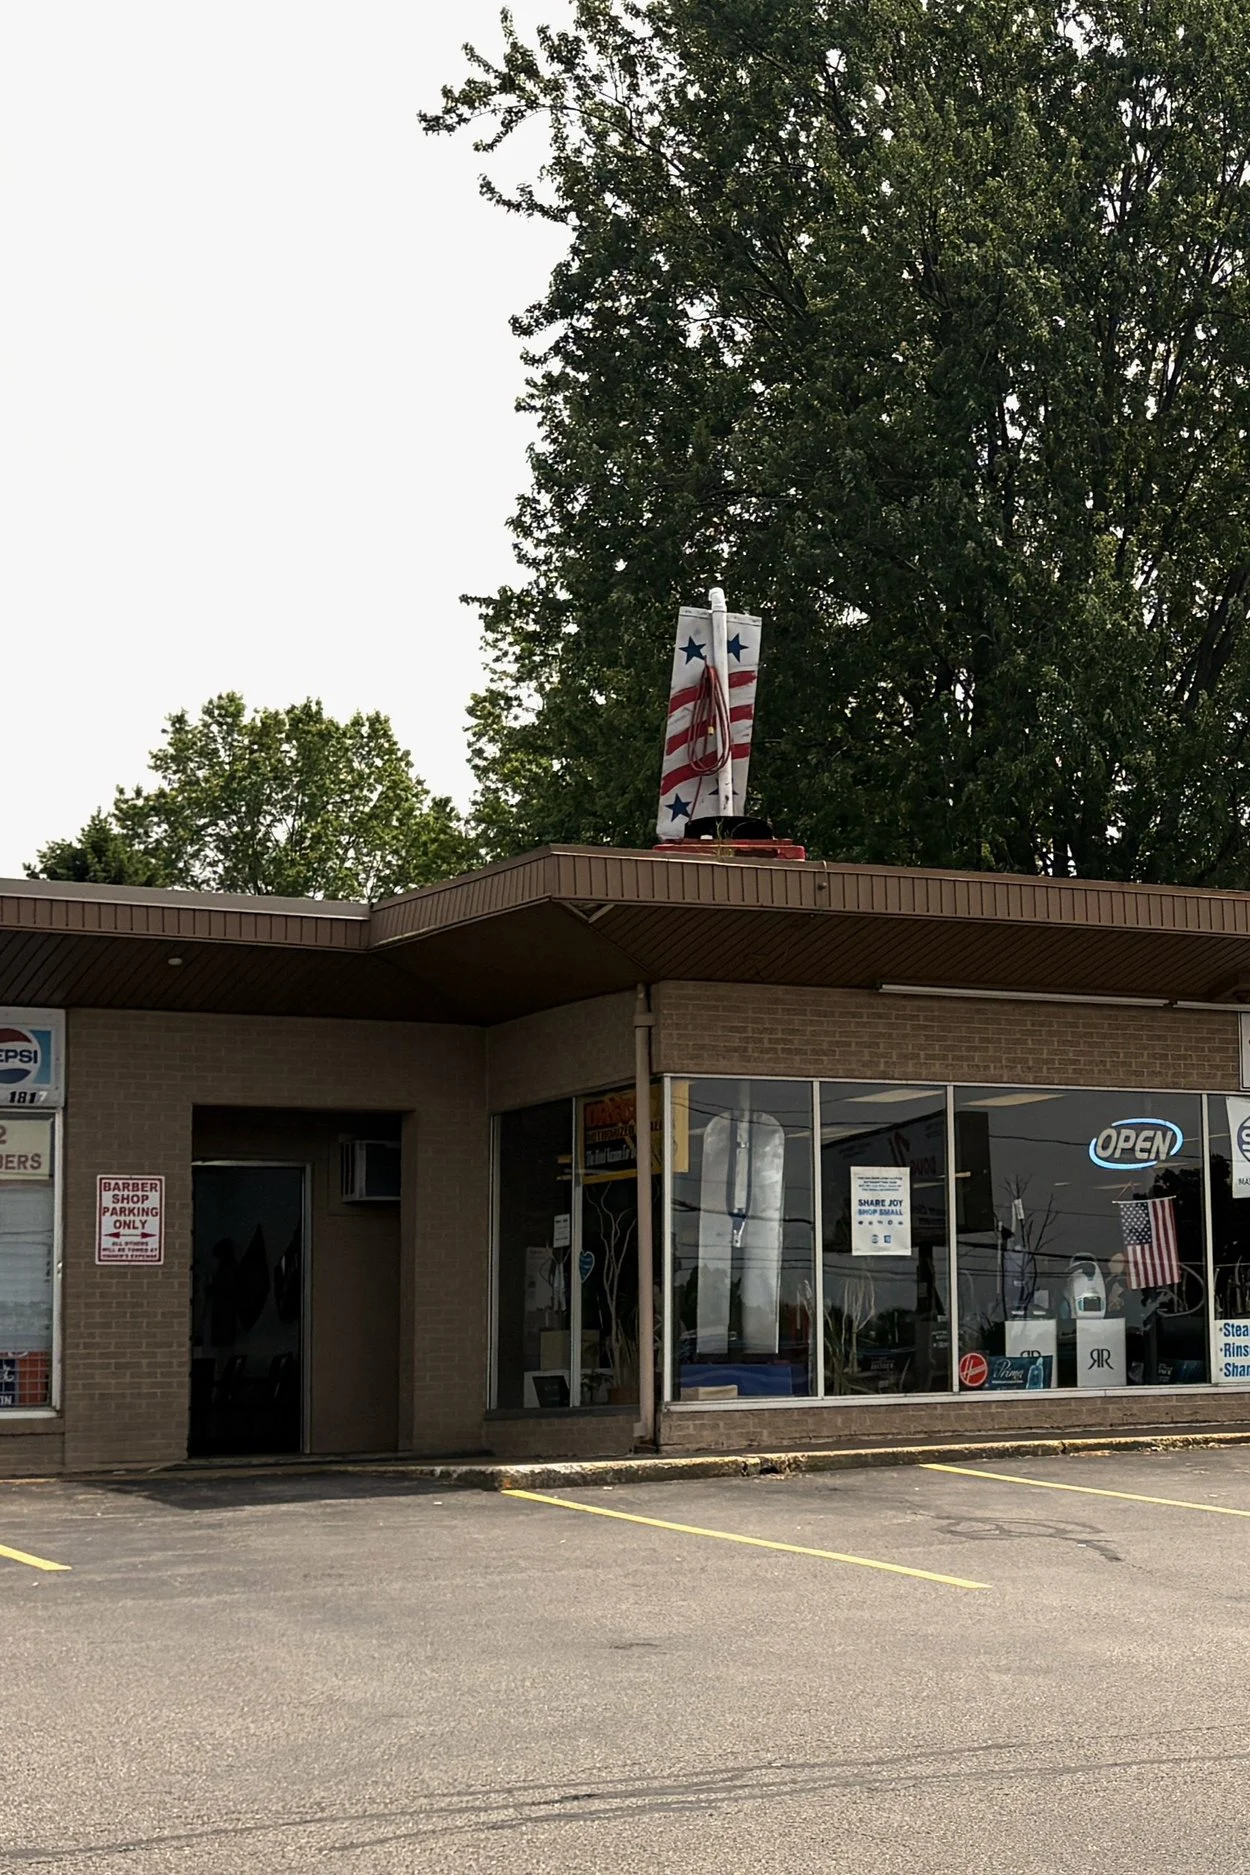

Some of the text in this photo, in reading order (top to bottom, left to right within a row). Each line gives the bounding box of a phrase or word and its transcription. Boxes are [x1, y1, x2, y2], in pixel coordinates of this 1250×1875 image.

[1096, 1128, 1173, 1160] OPEN
[103, 1182, 158, 1193] BARBER
[112, 1194, 149, 1204] SHOP
[858, 1199, 903, 1207] SHARE JOY
[102, 1206, 158, 1217] PARKING
[858, 1208, 878, 1216] SHOP
[113, 1219, 147, 1230] ONLY
